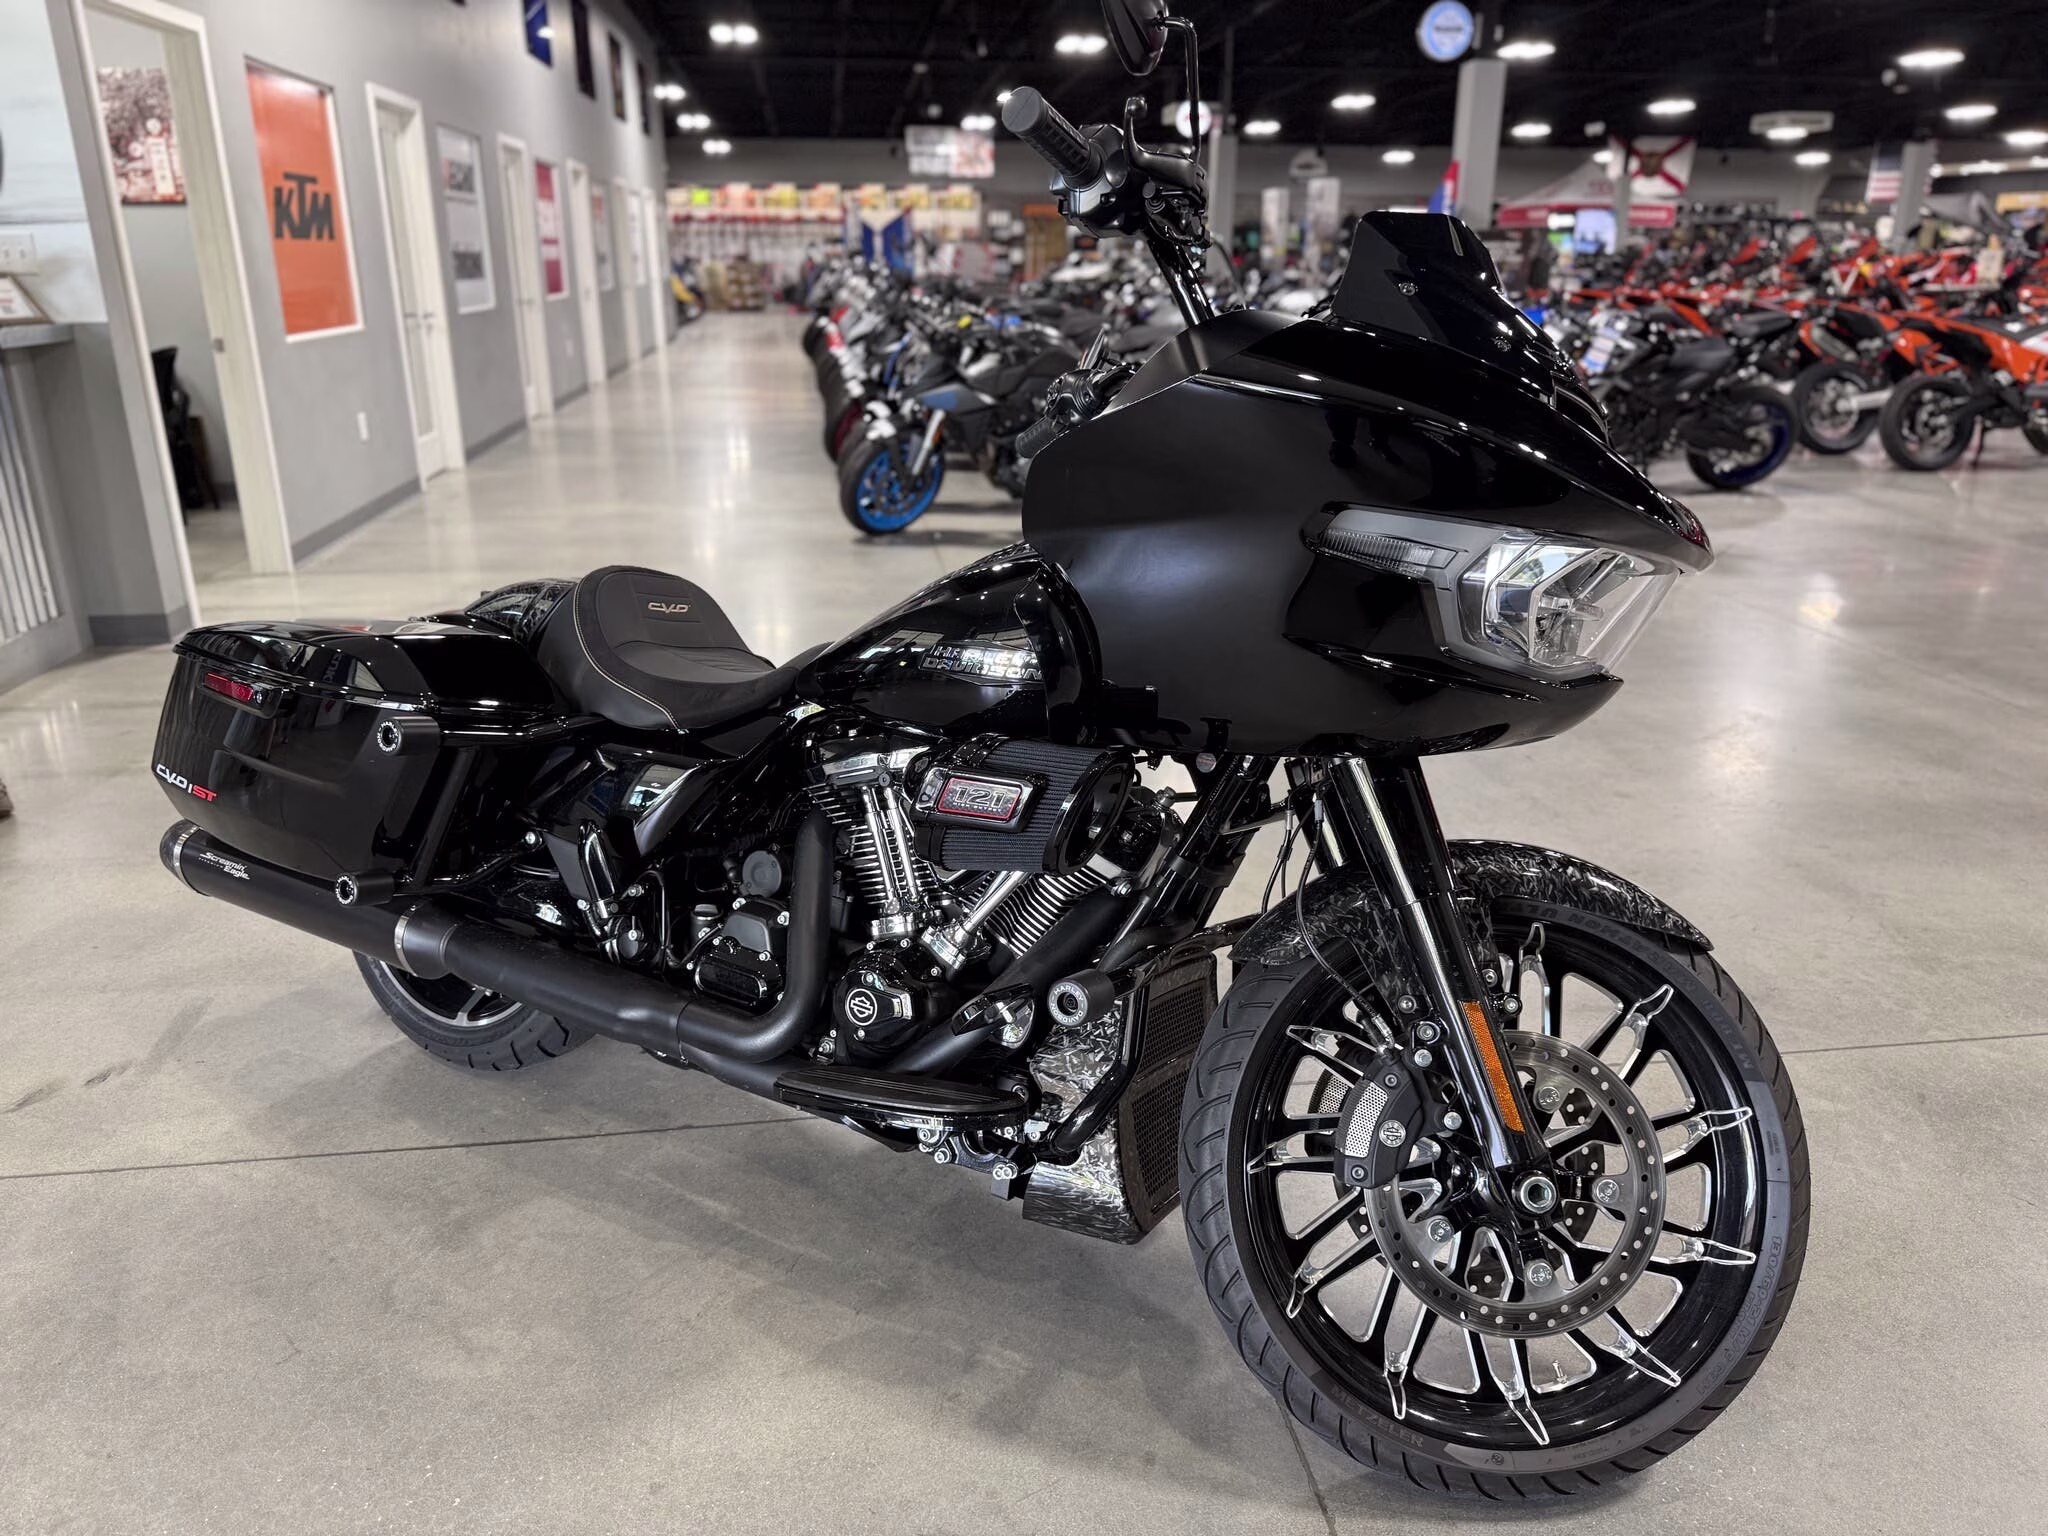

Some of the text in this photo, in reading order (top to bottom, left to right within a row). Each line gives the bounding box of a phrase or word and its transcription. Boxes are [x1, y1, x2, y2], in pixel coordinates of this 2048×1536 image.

[274, 172, 334, 241] KTM
[954, 786, 1006, 808] 121
[223, 865, 250, 880] Eagle
[1054, 985, 1084, 1001] HARLEY
[1051, 1003, 1084, 1023] DAVIDSON
